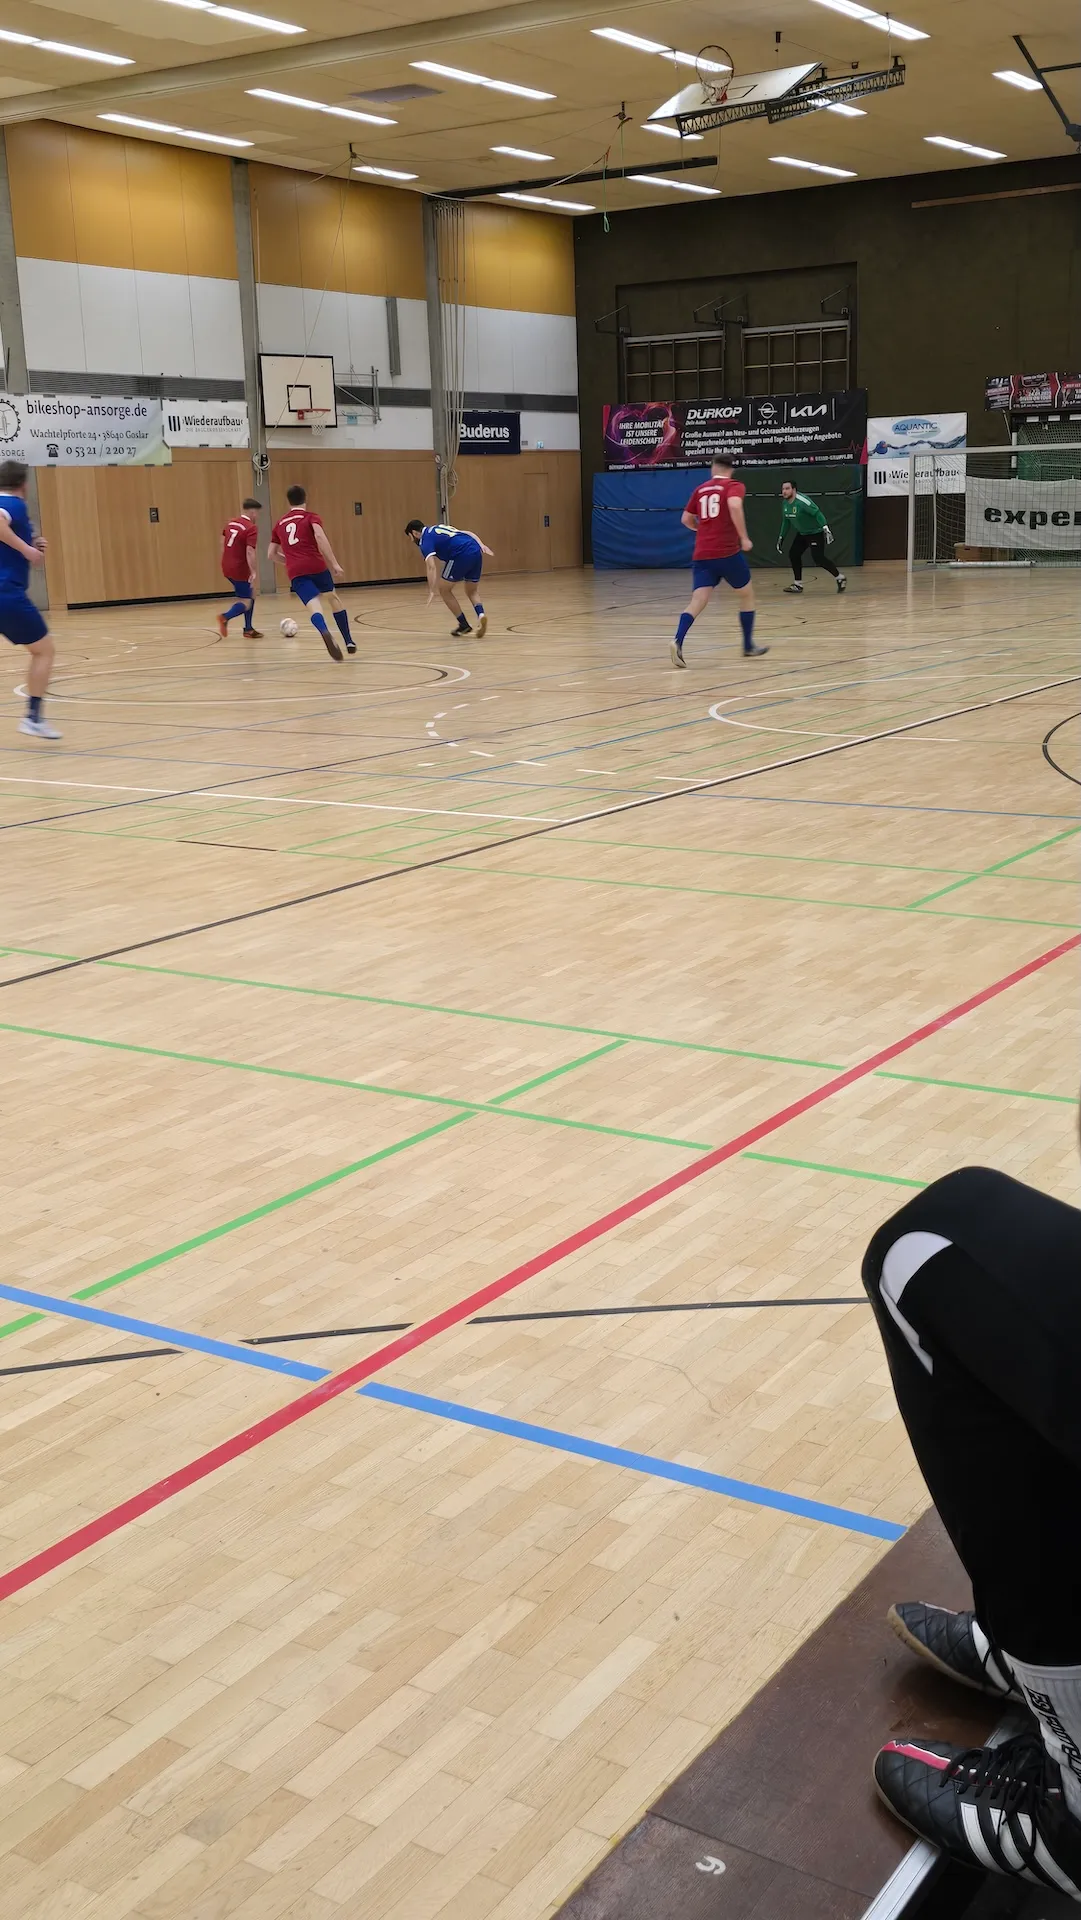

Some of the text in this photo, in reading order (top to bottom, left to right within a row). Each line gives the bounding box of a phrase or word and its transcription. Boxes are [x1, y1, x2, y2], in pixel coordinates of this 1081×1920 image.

[26, 399, 147, 420] bikeshop-ansorge.de
[687, 407, 742, 419] DÜRKOP
[791, 404, 827, 417] KIA
[634, 420, 664, 429] MOBILITÄT
[895, 422, 938, 431] AQUANTIC
[30, 429, 149, 440] Wachtelpforte 24 38640 Goslar
[459, 424, 509, 438] Buderus
[635, 429, 658, 437] UNSERE
[814, 432, 842, 441] Angebote
[75, 447, 85, 457] 53
[113, 447, 124, 455] 20
[126, 447, 137, 457] 27
[699, 494, 720, 518] 16
[226, 528, 239, 547] 7
[286, 522, 299, 545] 2
